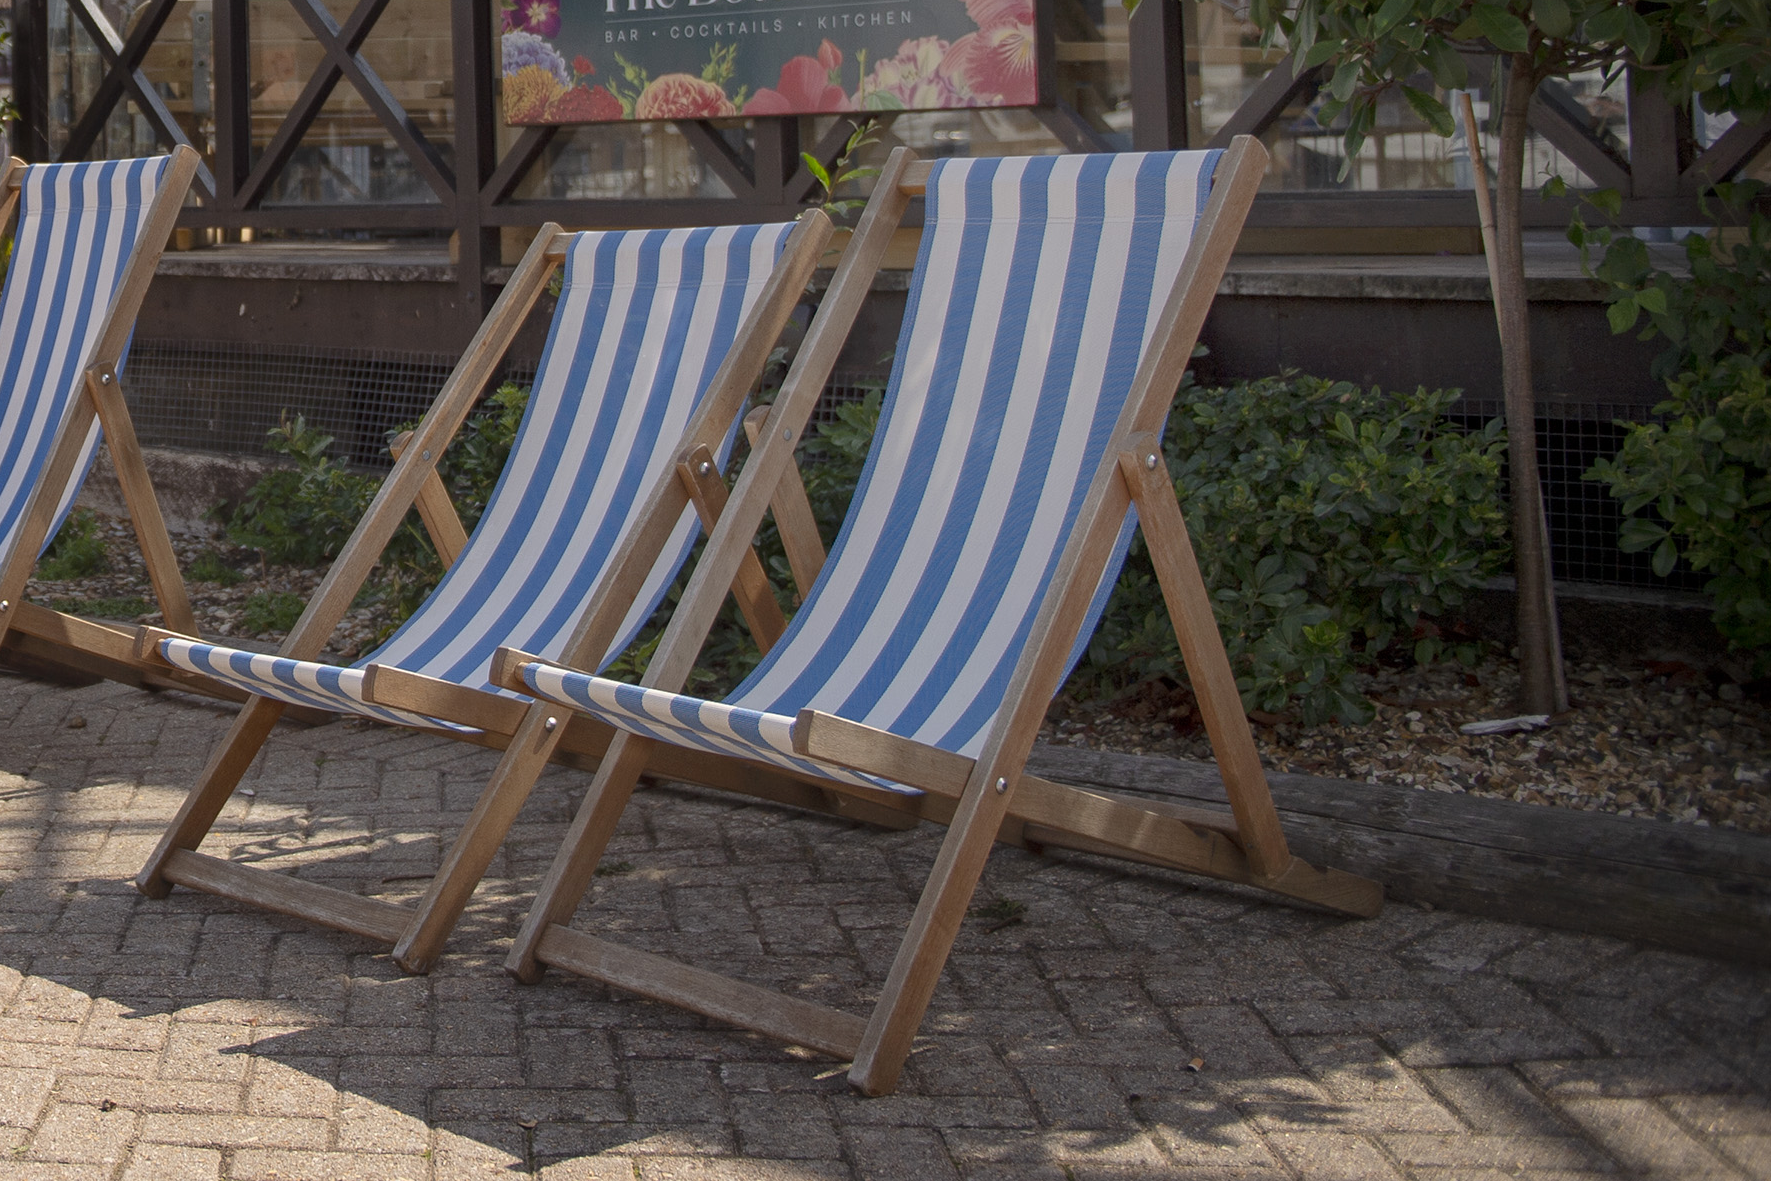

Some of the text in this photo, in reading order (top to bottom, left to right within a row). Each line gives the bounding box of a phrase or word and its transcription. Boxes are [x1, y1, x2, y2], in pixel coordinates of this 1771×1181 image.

[605, 11, 912, 44] BAR COCKTAILS KITCHEN
